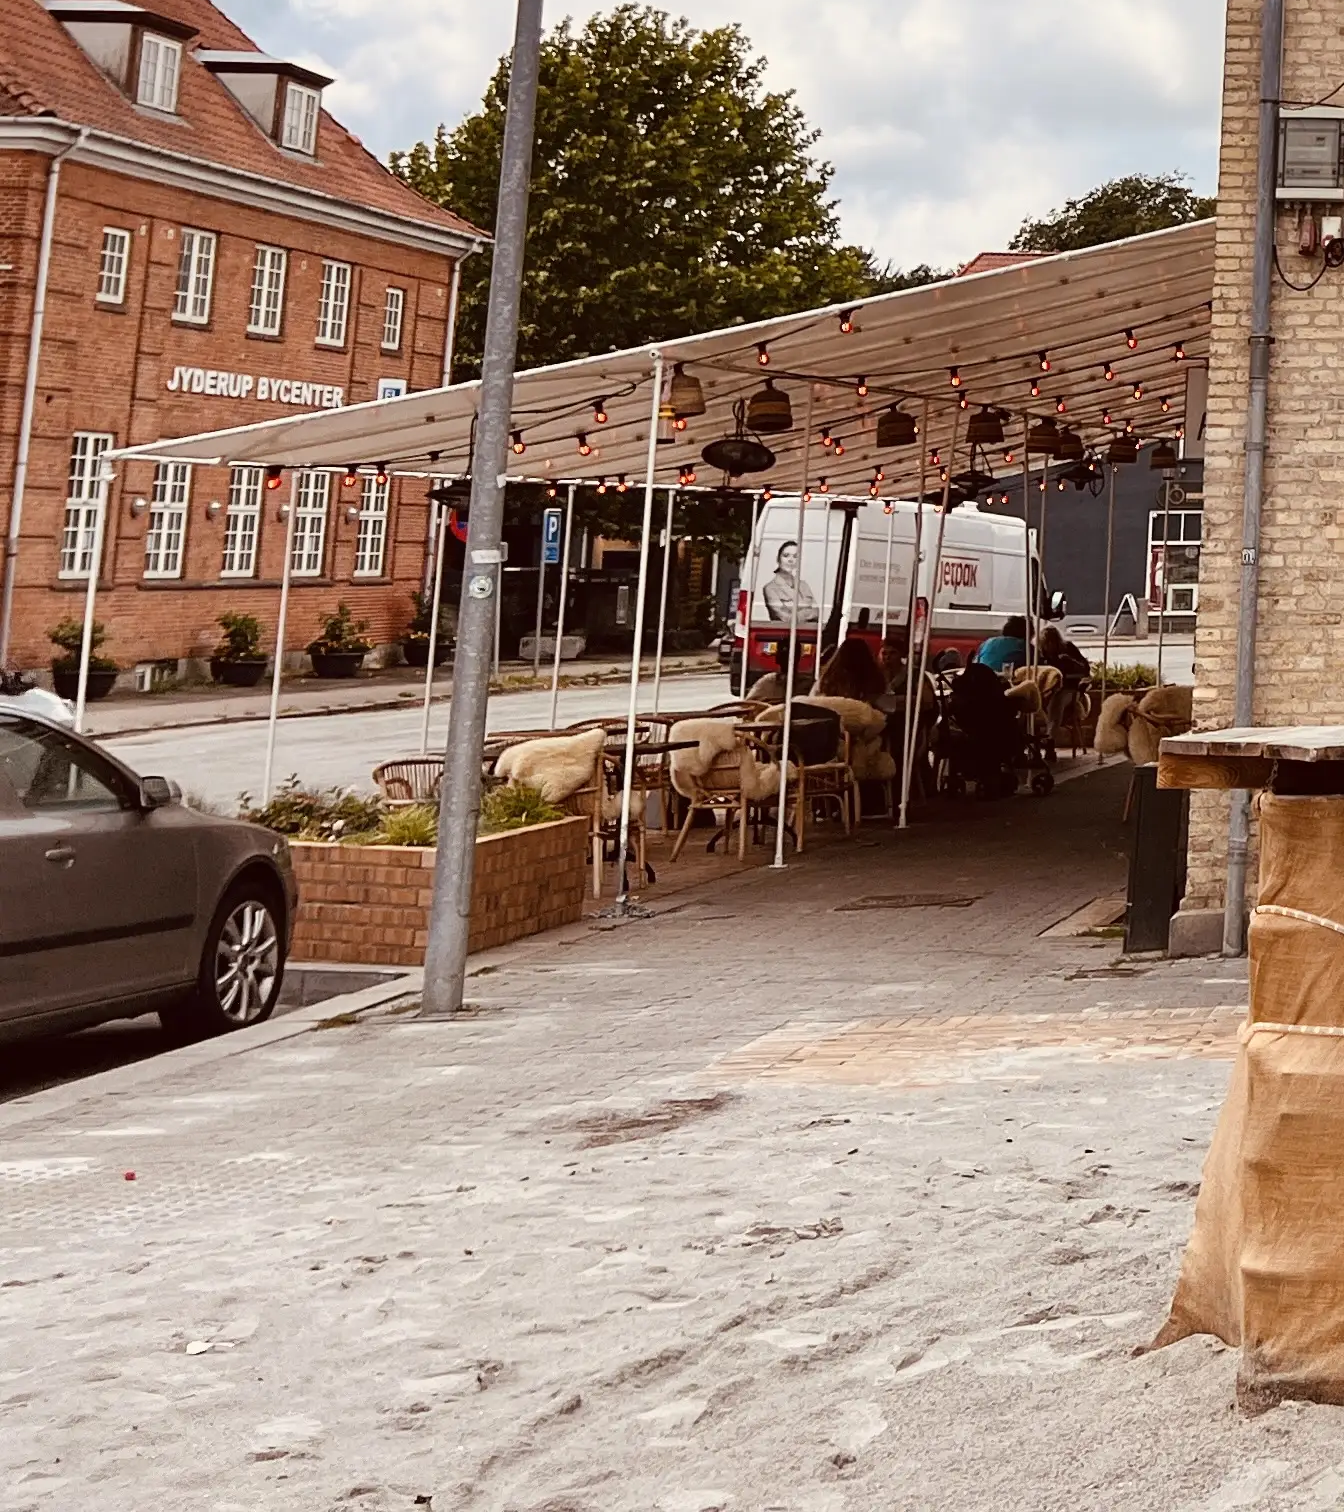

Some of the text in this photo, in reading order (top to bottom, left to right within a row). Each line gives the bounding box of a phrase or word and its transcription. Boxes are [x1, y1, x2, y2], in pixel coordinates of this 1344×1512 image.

[167, 366, 344, 408] JYDERUP BYCENTER
[548, 516, 558, 541] P
